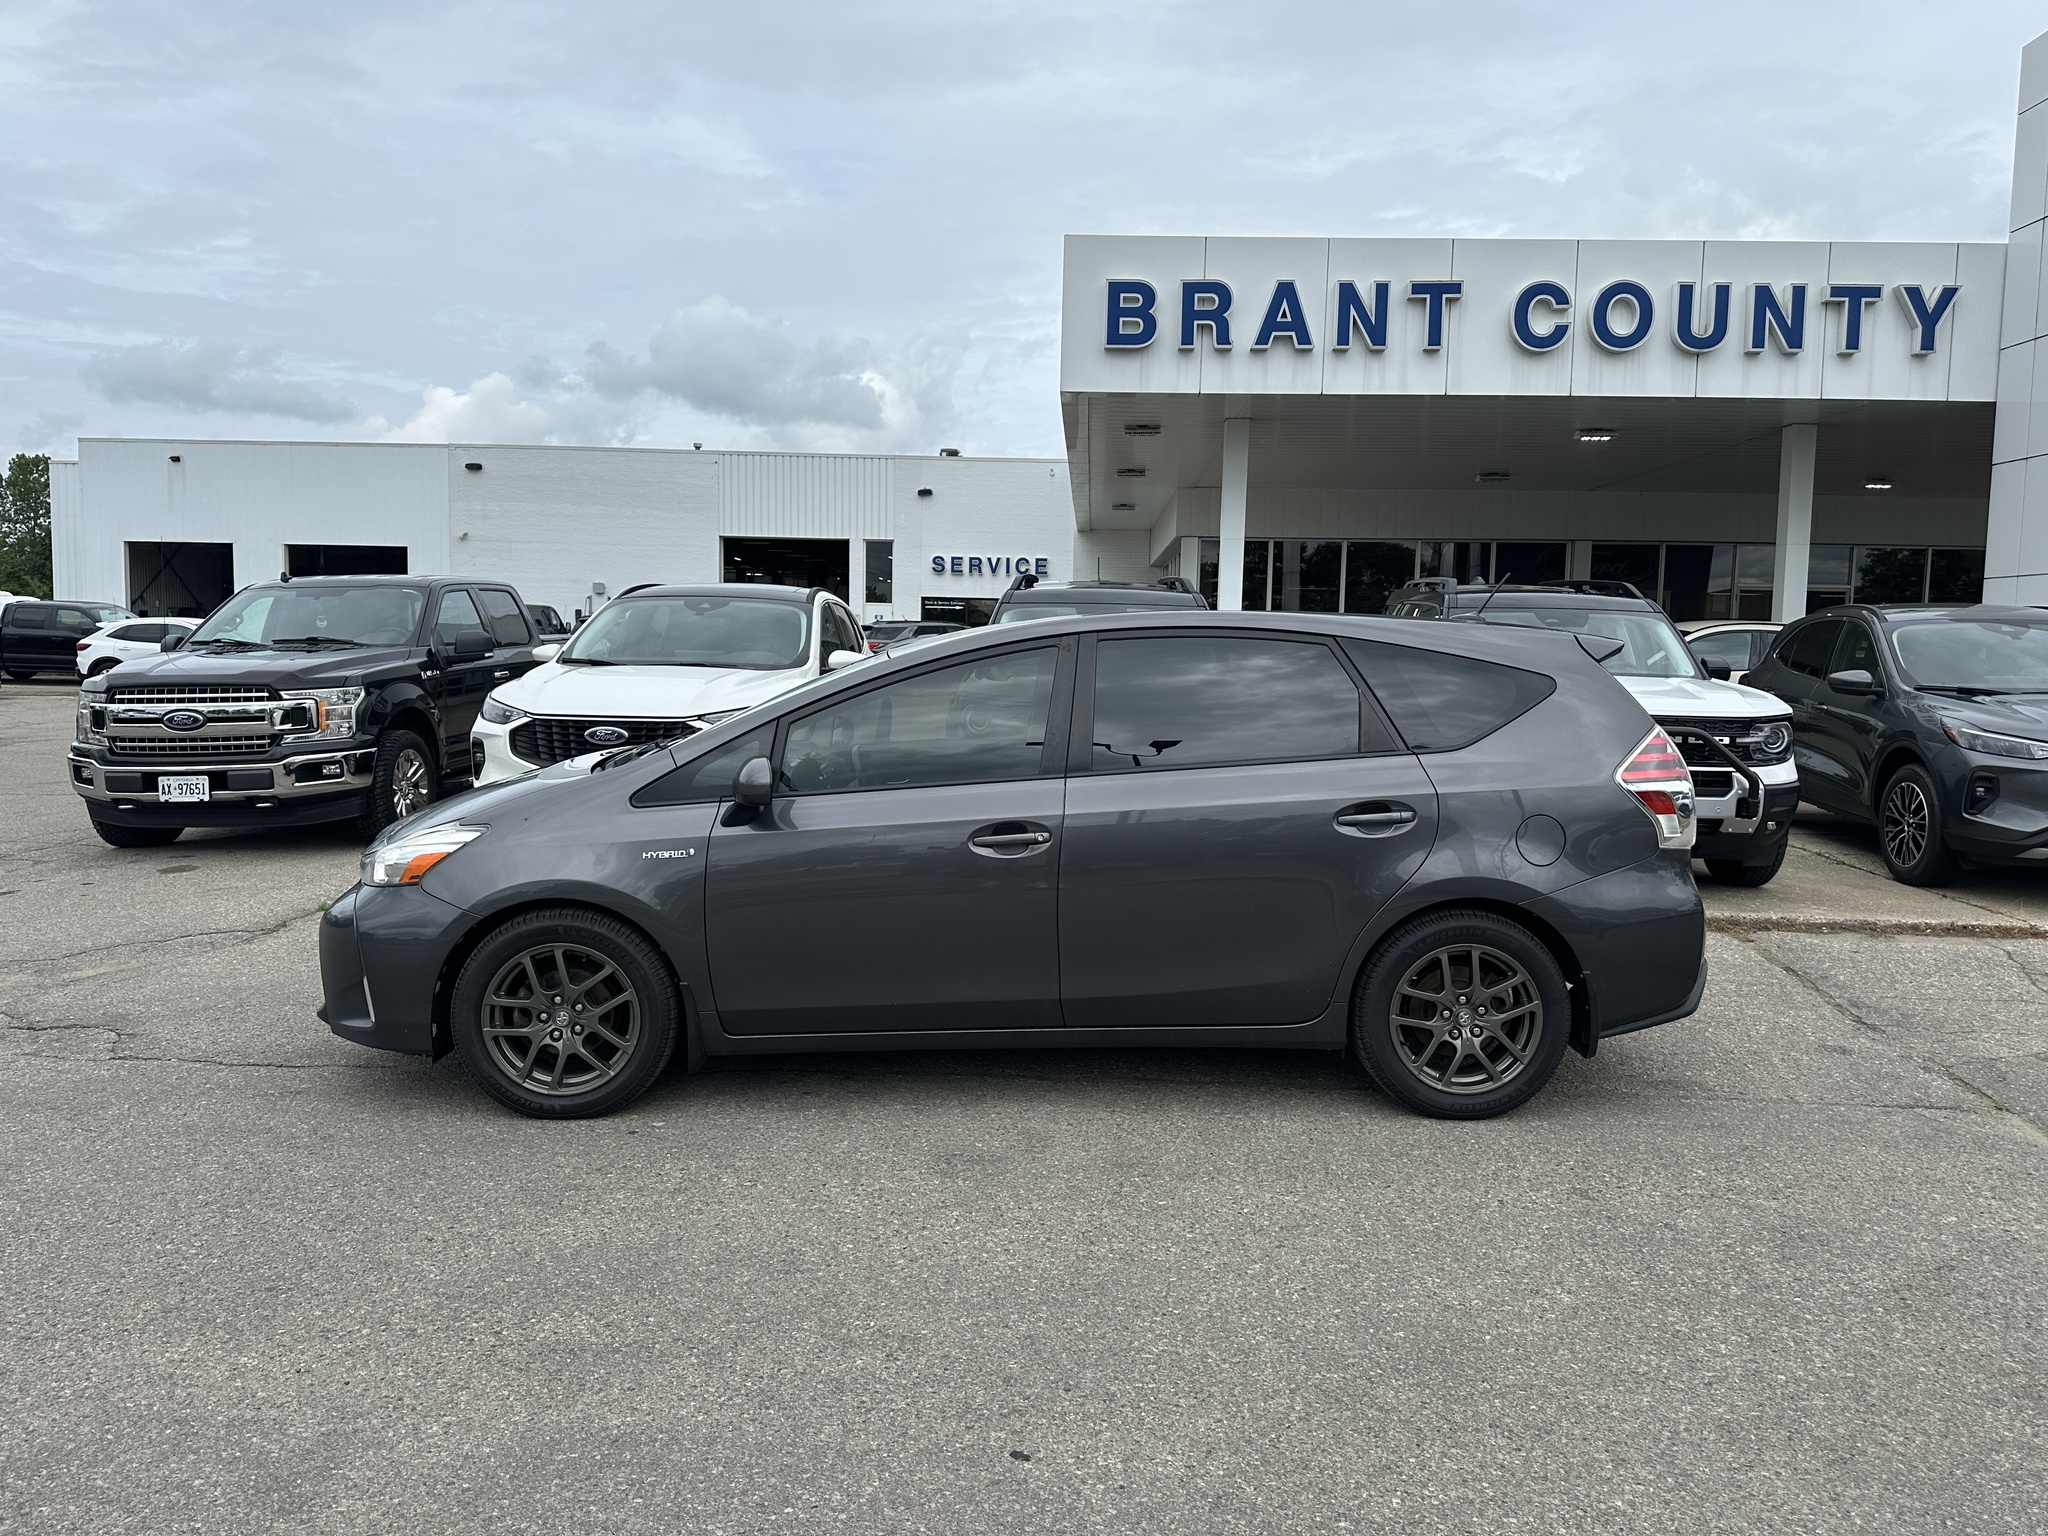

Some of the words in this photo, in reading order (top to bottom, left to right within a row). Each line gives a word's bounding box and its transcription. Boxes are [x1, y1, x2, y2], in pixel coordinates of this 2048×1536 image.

[1104, 279, 1465, 351] BRANT
[1509, 279, 1963, 357] COUNTY
[931, 555, 1049, 576] SERVICE
[172, 715, 193, 724] Ford
[594, 730, 617, 740] Ford
[161, 783, 172, 796] AX
[177, 782, 206, 796] 97651
[642, 850, 687, 860] HYBRID
